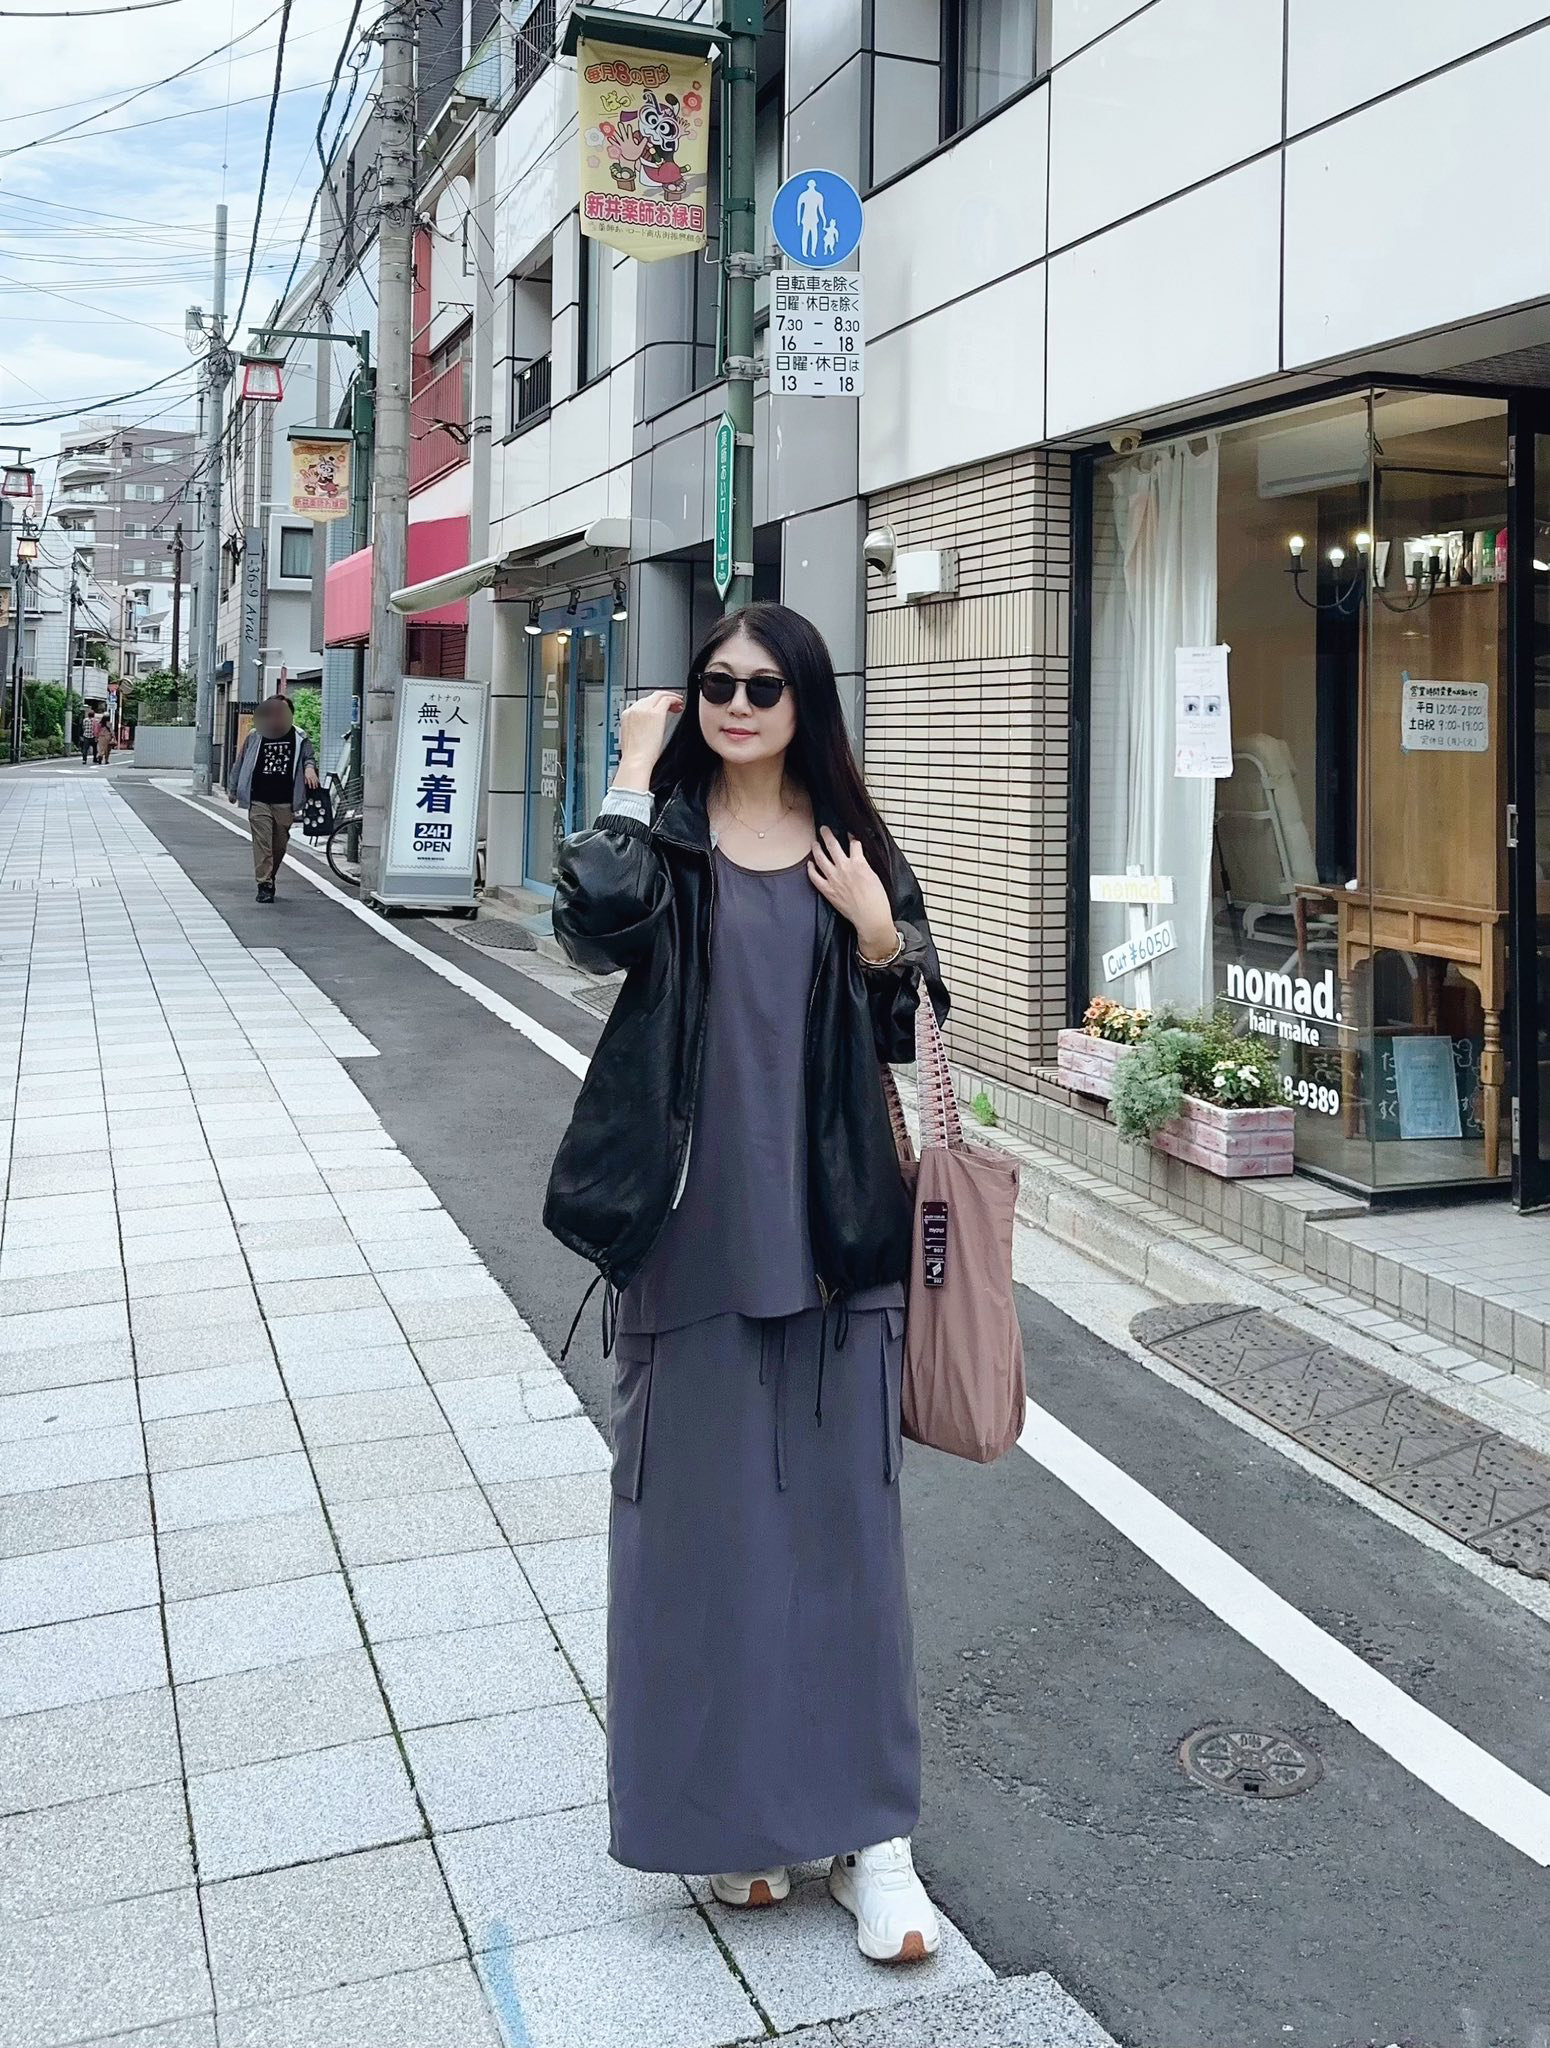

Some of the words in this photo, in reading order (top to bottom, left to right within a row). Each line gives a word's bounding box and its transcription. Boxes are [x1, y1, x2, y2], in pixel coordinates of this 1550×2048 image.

[585, 61, 669, 88] 毎月8の日は
[585, 191, 704, 232] 新井薬師お縁日
[776, 275, 859, 292] 自転車を除く
[776, 295, 860, 312] 日曜・休日を除く
[782, 335, 797, 351] 16
[839, 336, 854, 352] 18
[776, 356, 860, 372] 日曜・休日は
[782, 375, 797, 392] 13
[839, 376, 854, 392] 18
[246, 553, 260, 598] 1-36-9
[244, 604, 257, 644] Arai
[417, 703, 469, 725] 無人
[1416, 701, 1433, 713] 平日
[1408, 717, 1435, 730] 土日祝
[416, 730, 460, 813] 古着
[540, 778, 557, 798] OPEN
[417, 825, 449, 838] 24H
[412, 840, 451, 853] OPEN
[1108, 952, 1127, 975] Cut
[1129, 928, 1171, 966] ¥6050
[1227, 964, 1342, 1021] nomad.
[1249, 1008, 1277, 1036] hair
[1279, 1020, 1320, 1046] make
